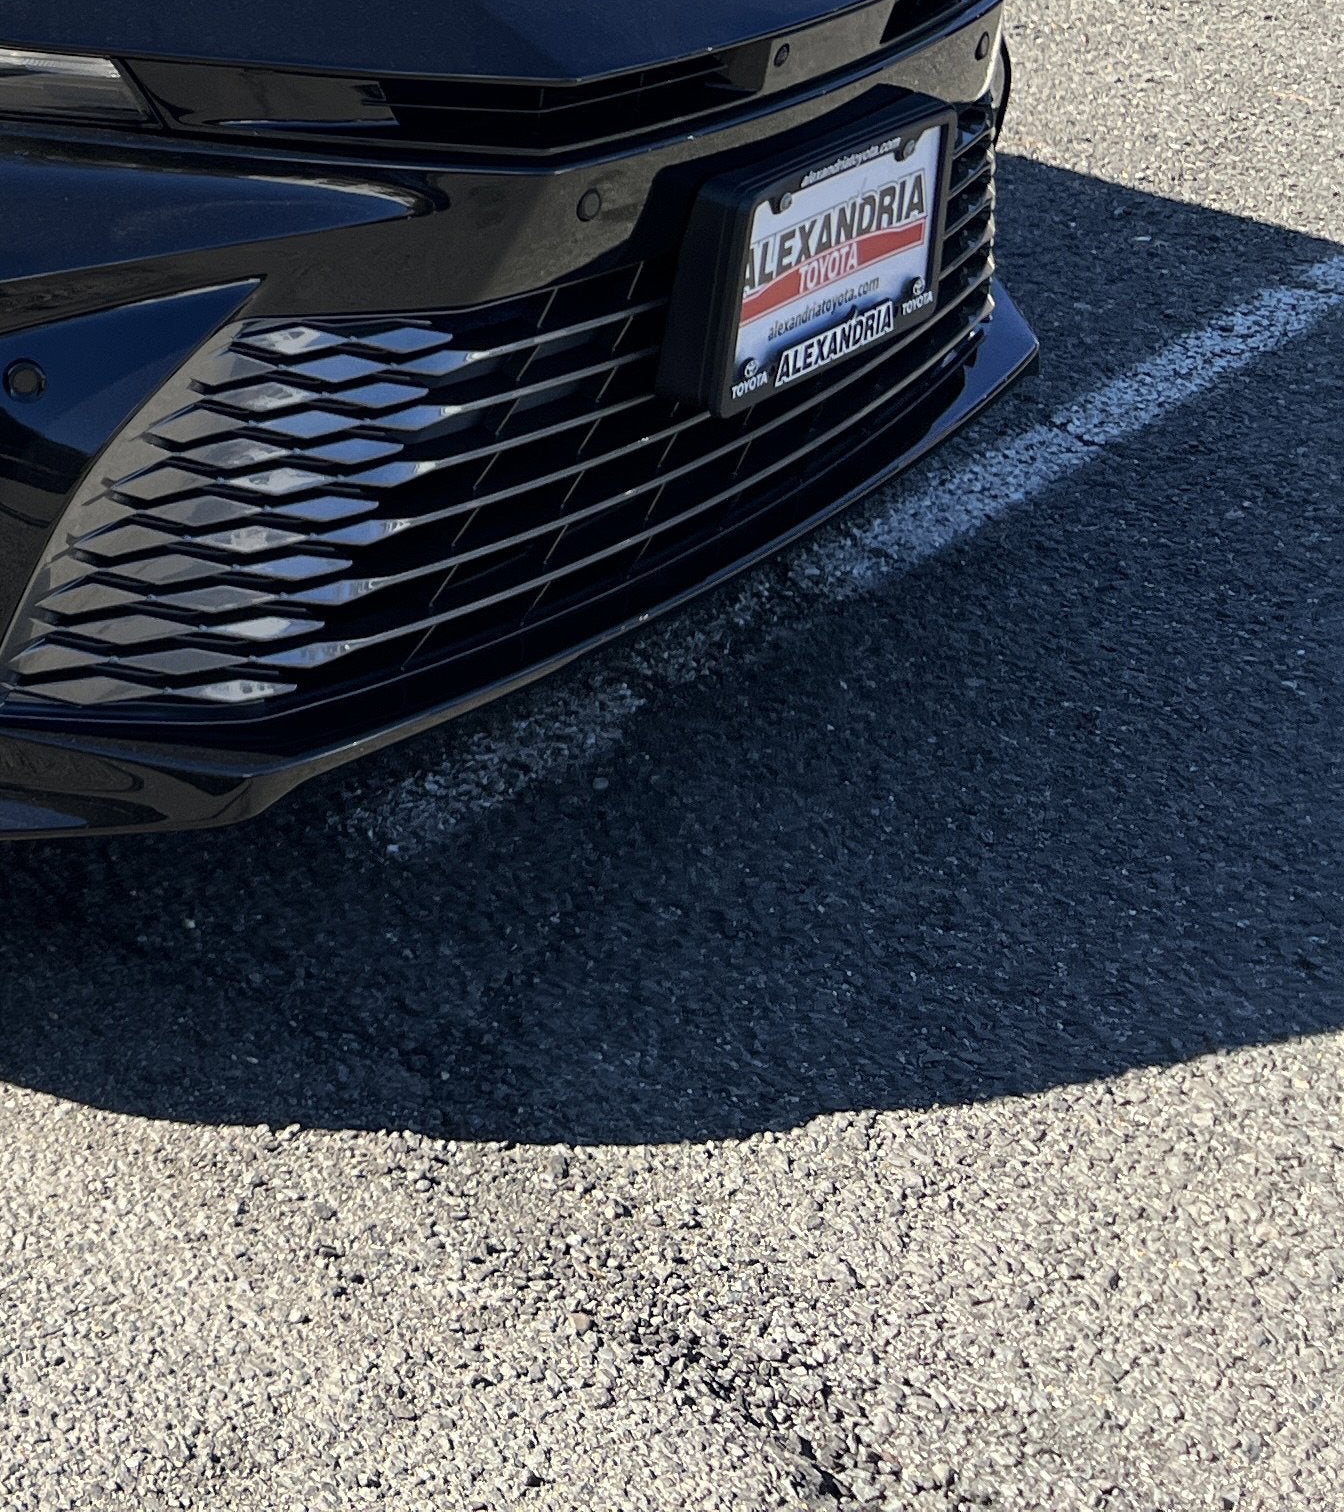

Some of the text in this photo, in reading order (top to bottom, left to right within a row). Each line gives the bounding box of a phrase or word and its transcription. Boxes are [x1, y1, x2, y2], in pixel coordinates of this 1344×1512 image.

[743, 174, 925, 290] ALEXANDRIA
[799, 243, 858, 294] TOYOTA
[768, 278, 879, 341] alexandriatoyota.com
[902, 291, 934, 316] TOYOTA
[776, 303, 892, 385] ALEXANDRIA
[732, 370, 768, 399] TOYOTA
